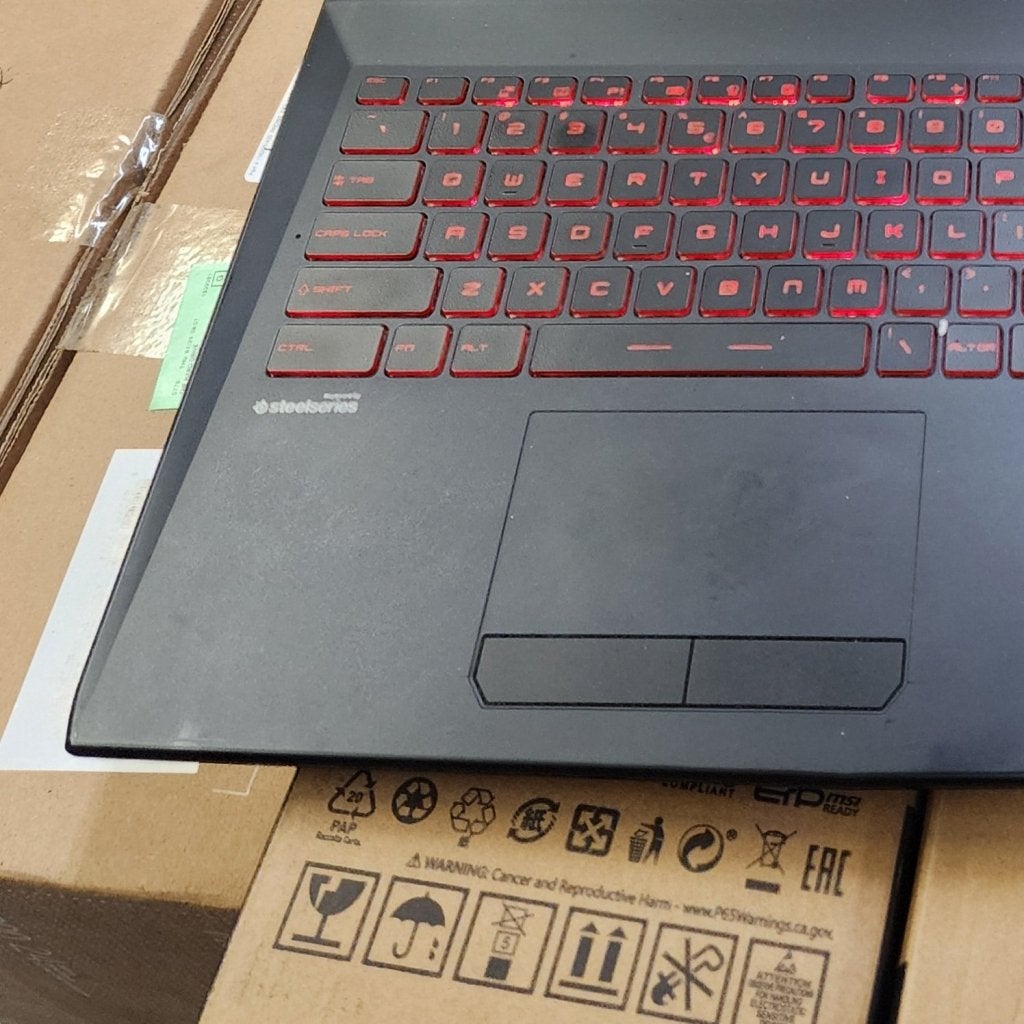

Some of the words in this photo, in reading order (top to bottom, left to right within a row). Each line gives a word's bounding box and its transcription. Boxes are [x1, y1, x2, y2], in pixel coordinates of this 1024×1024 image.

[506, 121, 526, 136] 2
[806, 118, 826, 133] 7
[503, 172, 524, 187] W
[563, 172, 584, 187] E
[626, 171, 646, 186] R
[688, 170, 707, 186] T
[751, 170, 767, 185] Y
[810, 170, 830, 185] U
[994, 169, 1015, 184] P
[353, 228, 389, 238] LOCK
[444, 225, 466, 241] A
[507, 225, 528, 240] S
[633, 224, 654, 239] F
[758, 223, 779, 239] H
[820, 223, 841, 239] J
[884, 223, 904, 239] K
[947, 223, 967, 239] L
[311, 283, 353, 295] SHIFT
[459, 281, 482, 297] Z
[526, 281, 547, 297] X
[589, 280, 611, 297] C
[656, 280, 675, 297] V
[276, 342, 315, 353] CTRL
[459, 342, 489, 353] ALT
[268, 398, 359, 414] steelseries
[347, 791, 364, 804] 20
[823, 803, 860, 817] READY
[330, 819, 358, 835] PAP
[800, 843, 852, 898] EAC
[423, 855, 490, 882] WARNING:
[491, 867, 532, 886] Cancer
[533, 873, 558, 890] and
[560, 878, 637, 906] Reproductive
[638, 891, 673, 911] Harm
